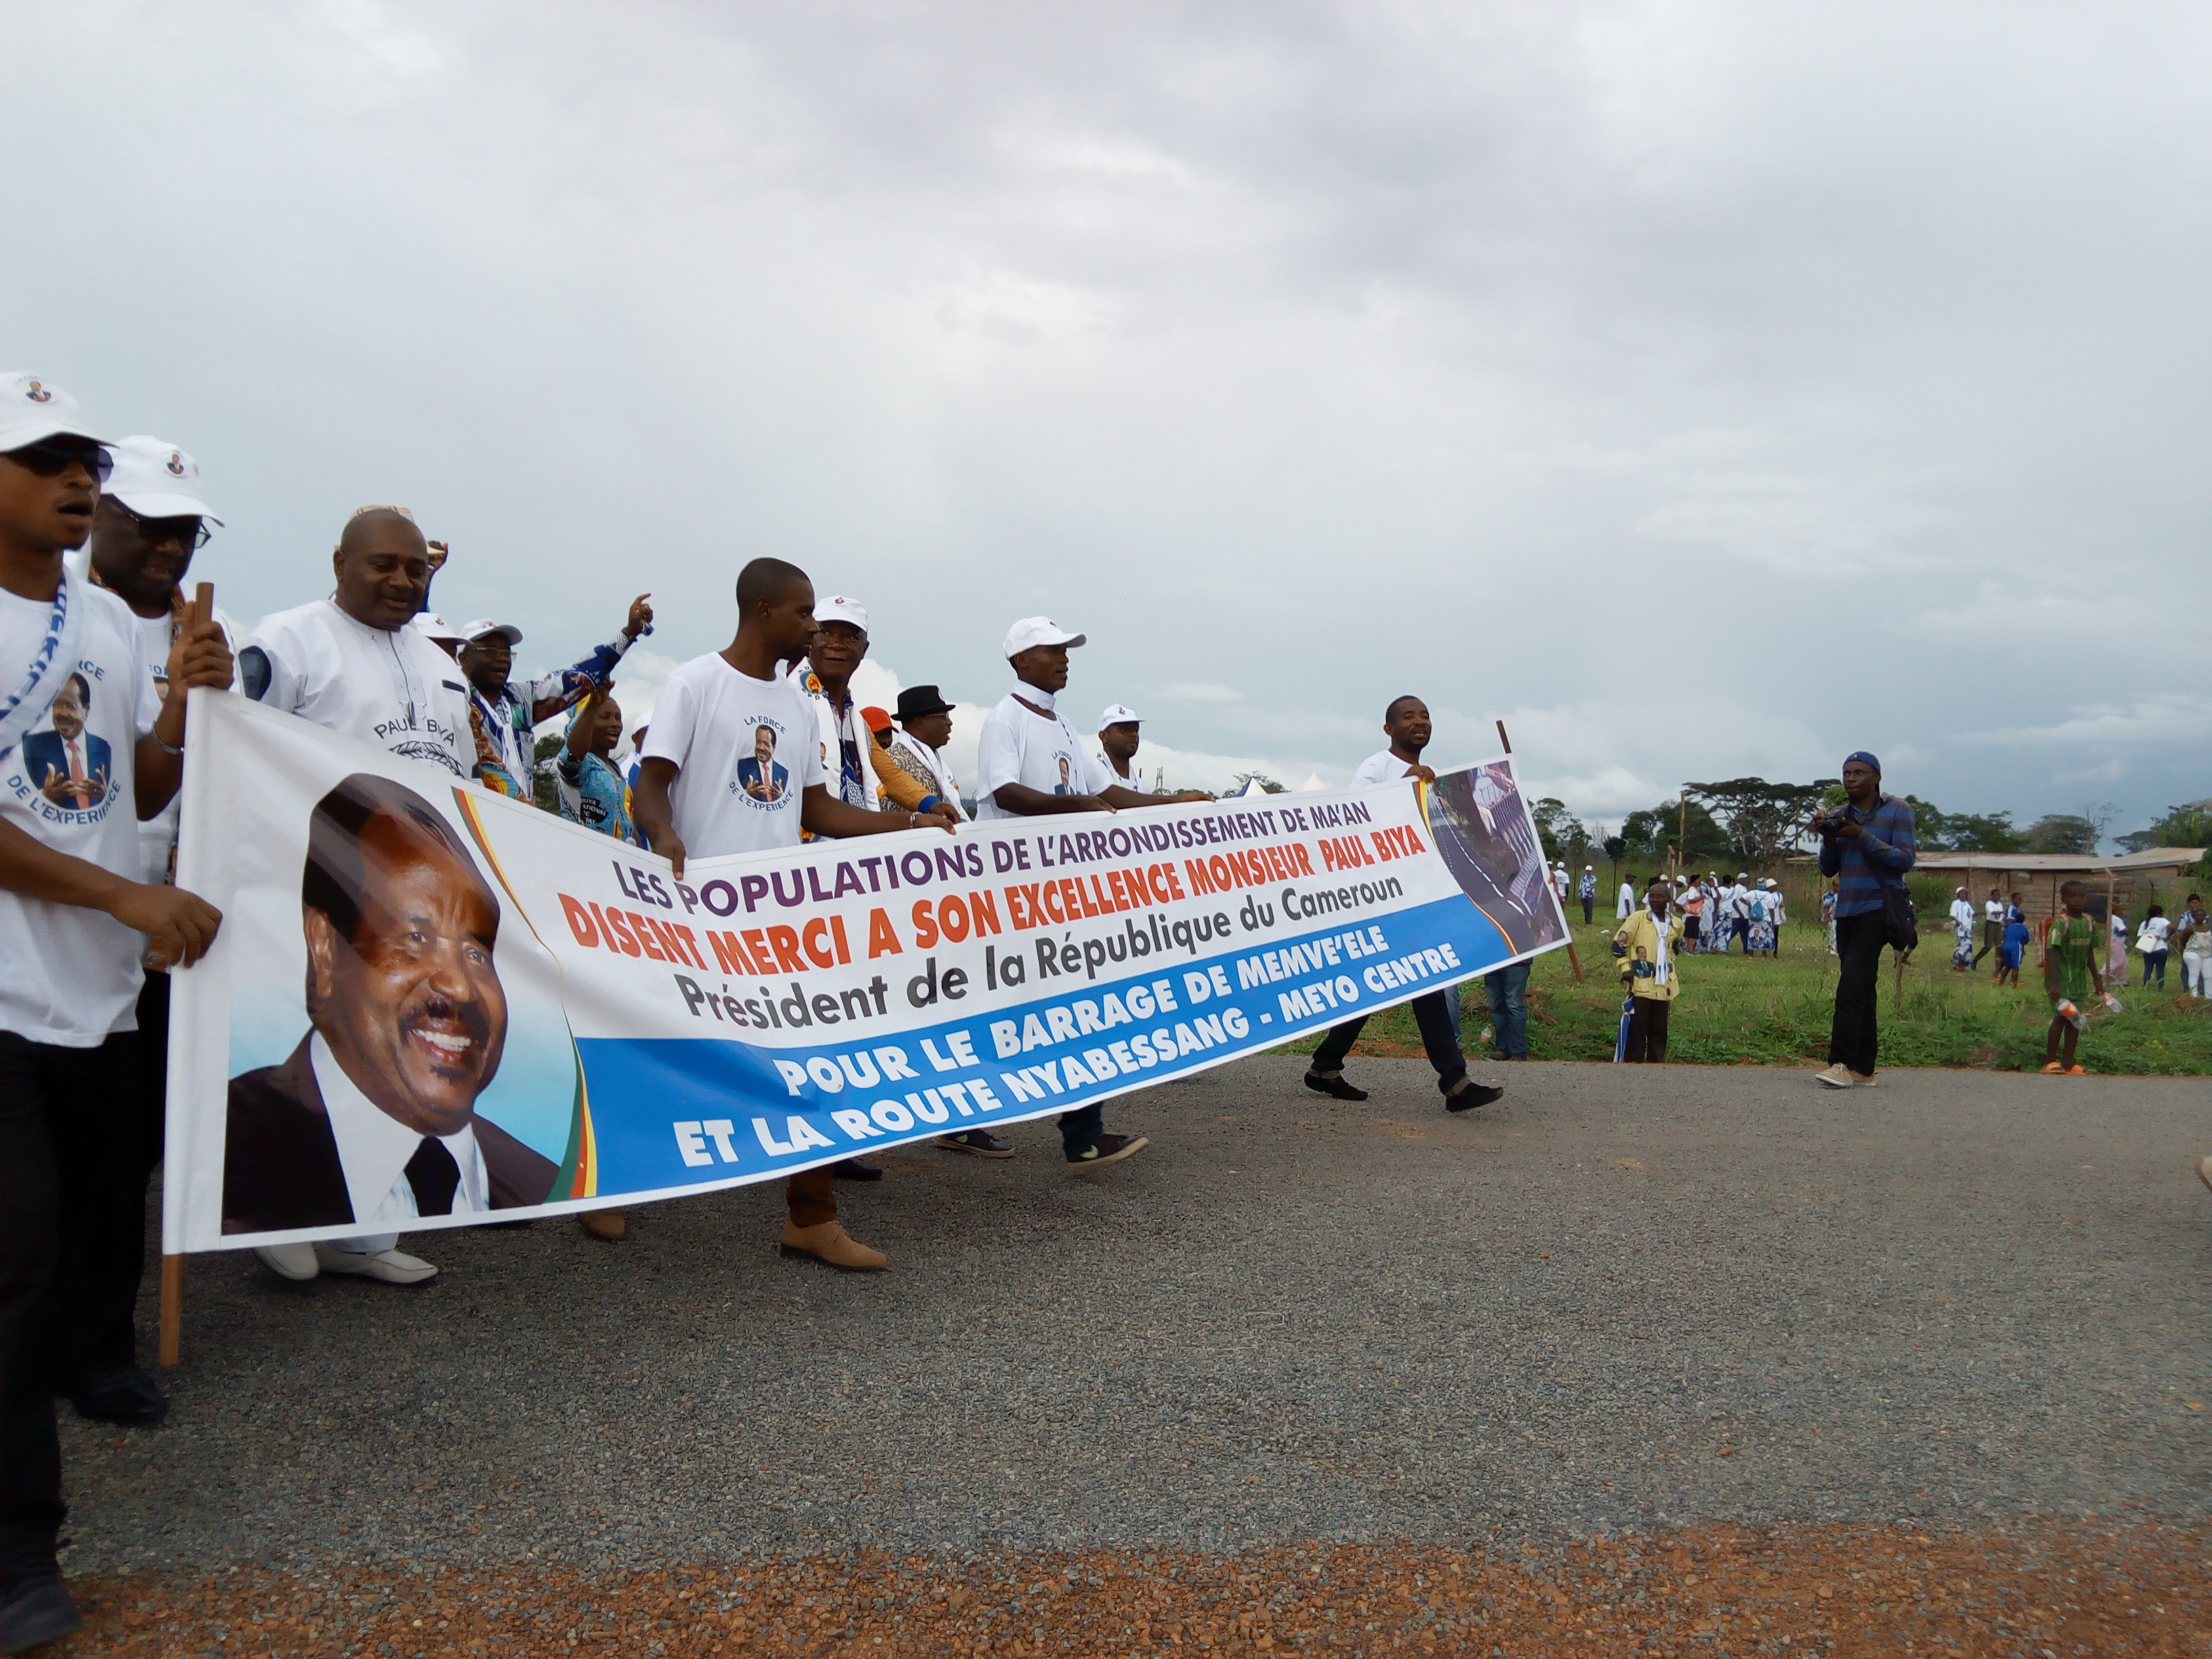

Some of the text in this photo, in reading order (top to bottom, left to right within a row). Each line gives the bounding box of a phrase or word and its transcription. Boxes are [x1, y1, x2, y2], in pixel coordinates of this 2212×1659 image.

[373, 718, 417, 739] PAUL
[743, 716, 786, 735] LA FORCE
[7, 775, 121, 825] DE L'EXPERIENCE
[729, 781, 794, 812] DE L'EXPERIENCE
[557, 825, 1427, 975] DISENT MERCI A SON EXCELLENCE MONSIEUR PAUL BIYA
[612, 800, 1372, 916] LES POPULATIONS DE L'ARRONDISSEMENT DE MA'AN
[674, 876, 1404, 1029] Président de la République du Cameroun
[773, 924, 1389, 1097] POUR LE BARRAGE DE MEMVE'ELE
[673, 1119, 739, 1167] ET
[752, 1115, 836, 1157] LA
[830, 1078, 1003, 1140] ROUTE
[1003, 1007, 1250, 1103] NYABESSANG
[1277, 975, 1359, 1023] MEYO
[1364, 943, 1462, 994] CENTRE
